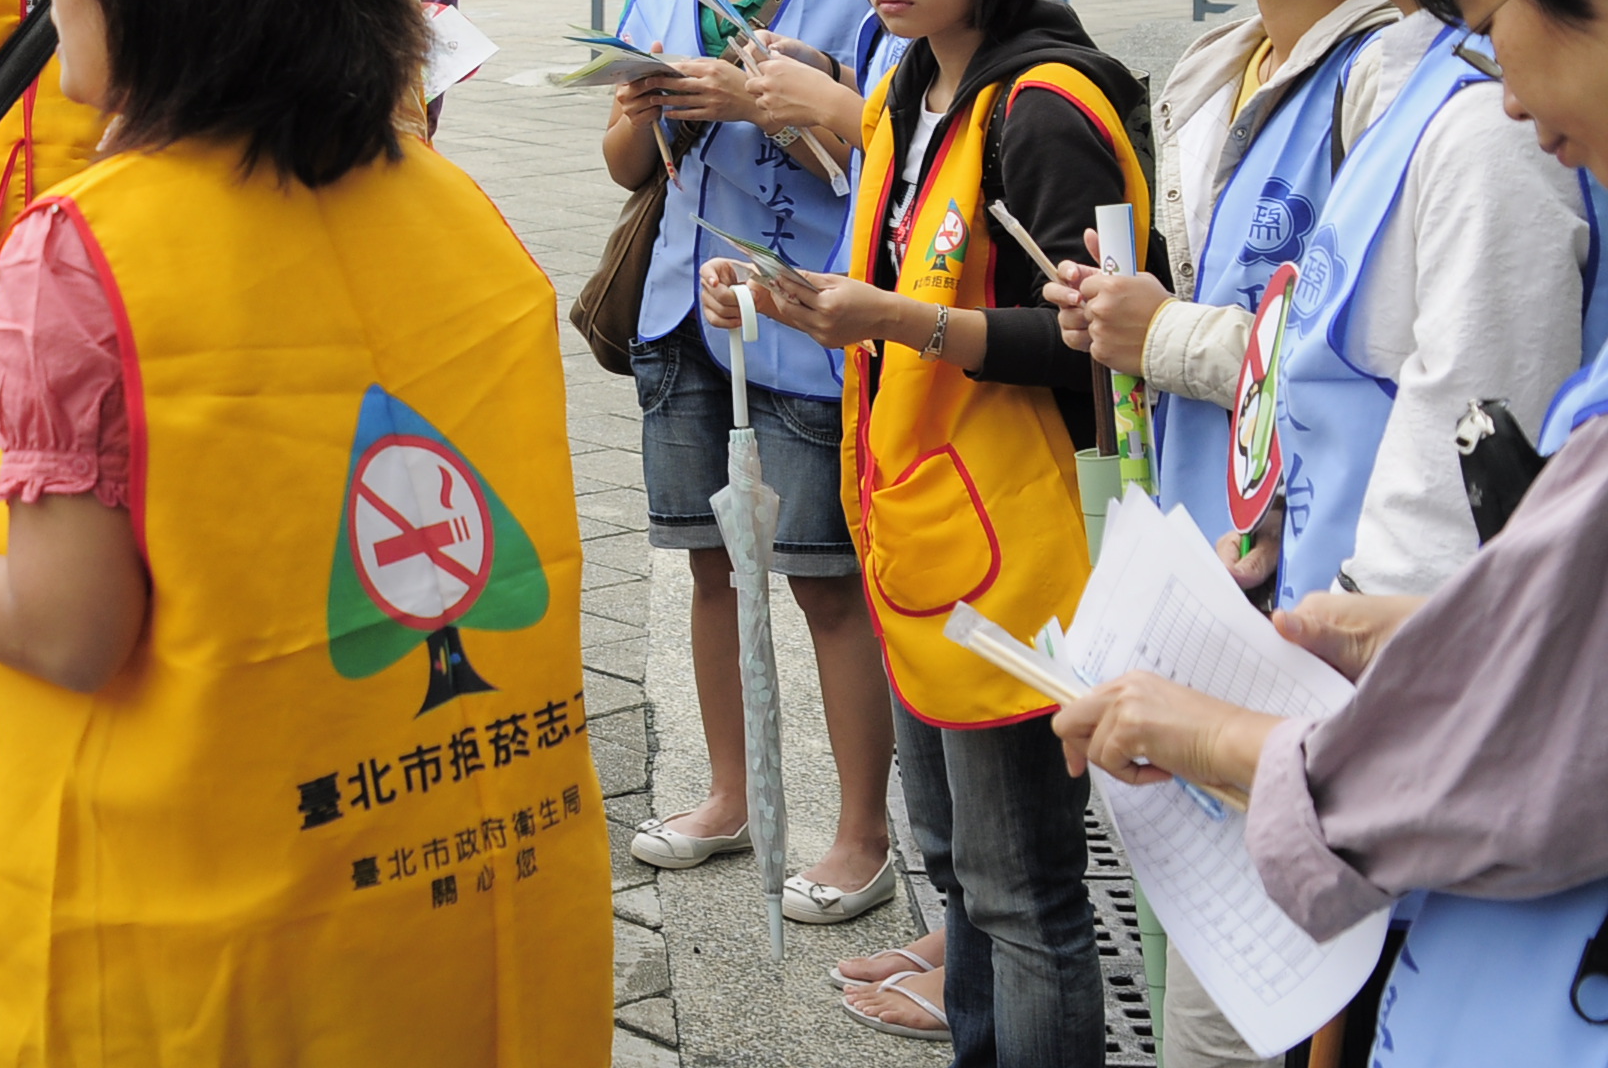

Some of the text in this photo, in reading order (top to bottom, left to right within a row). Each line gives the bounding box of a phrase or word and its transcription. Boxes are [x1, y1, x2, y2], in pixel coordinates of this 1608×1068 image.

[351, 783, 582, 891] 臺北市政府衛生局
